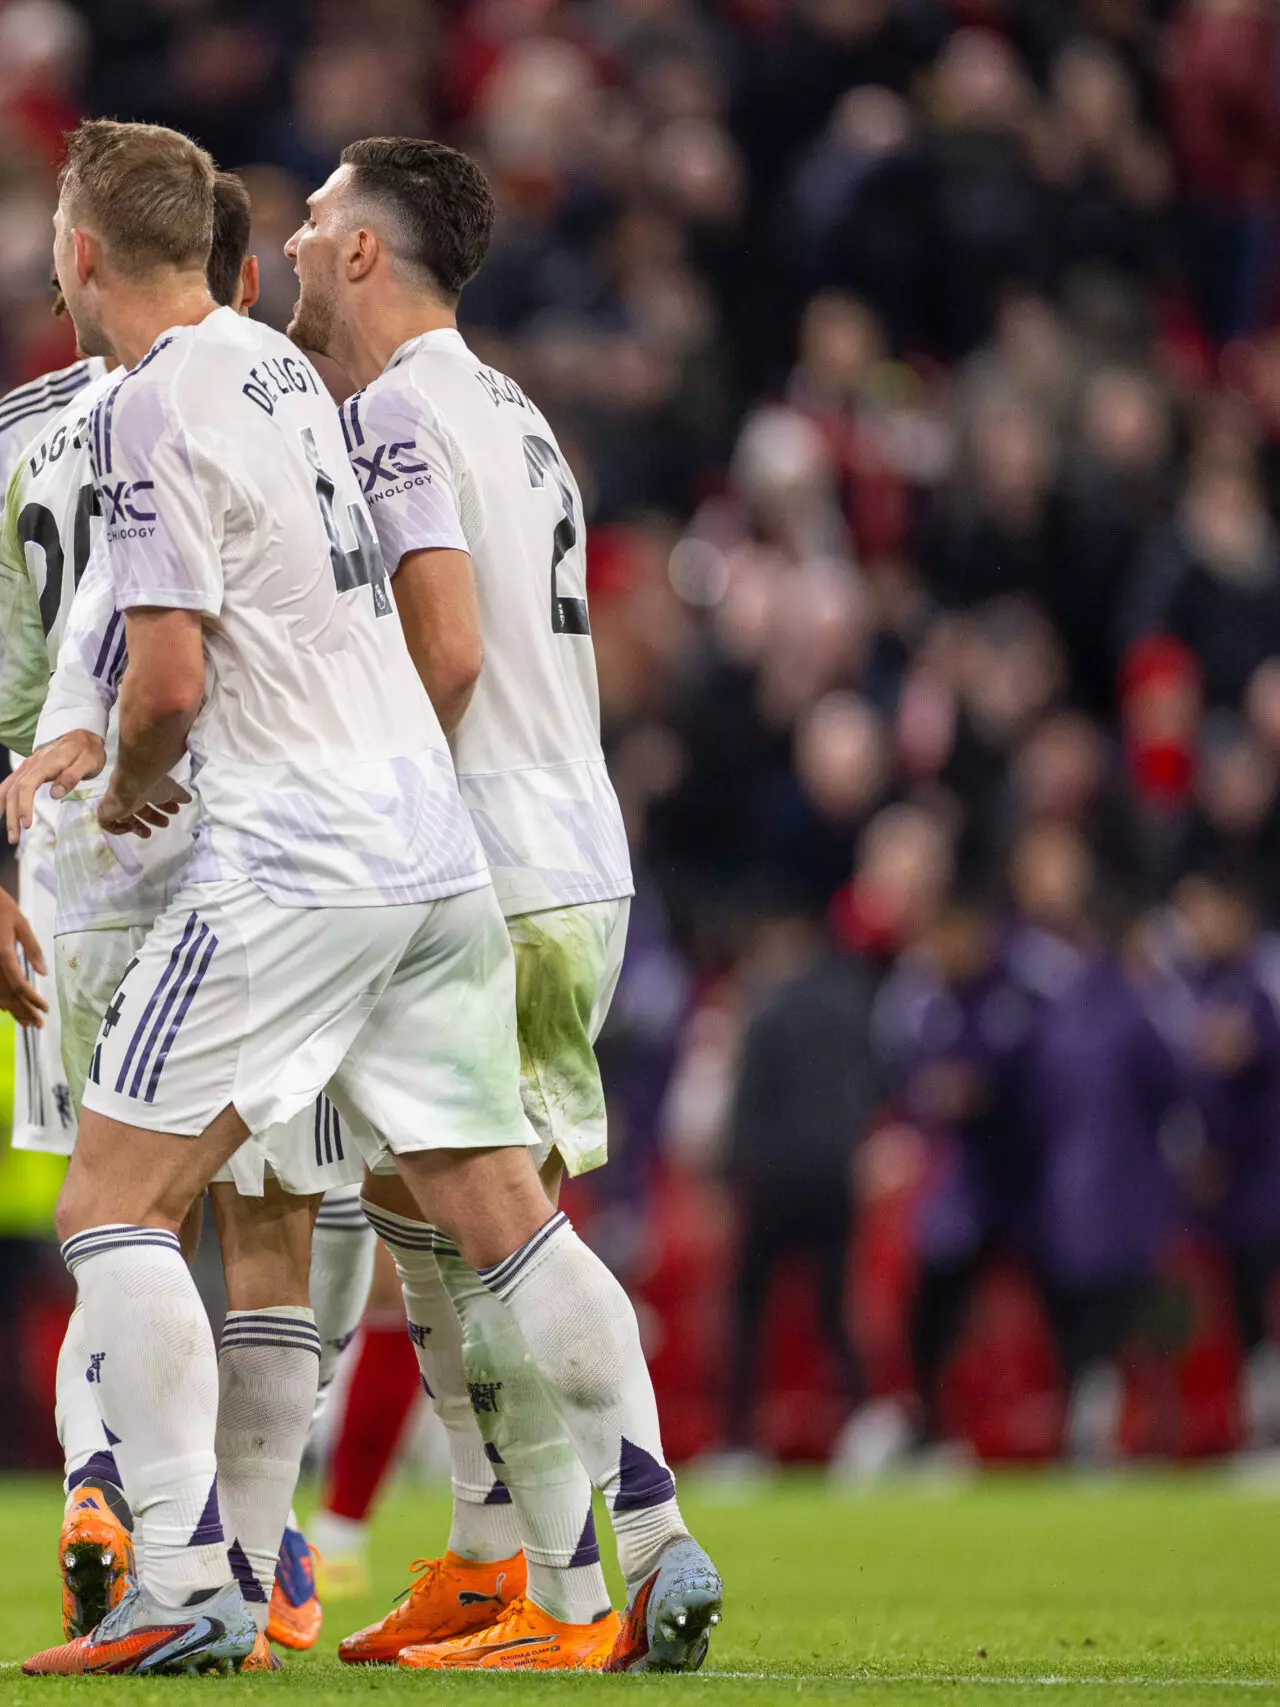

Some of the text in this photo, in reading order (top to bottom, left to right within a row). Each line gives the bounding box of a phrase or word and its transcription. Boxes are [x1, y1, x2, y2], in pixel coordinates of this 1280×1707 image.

[242, 367, 278, 416] DE
[350, 441, 429, 493] XC
[96, 481, 157, 525] XC
[297, 424, 394, 618] 4
[522, 434, 591, 636] 2
